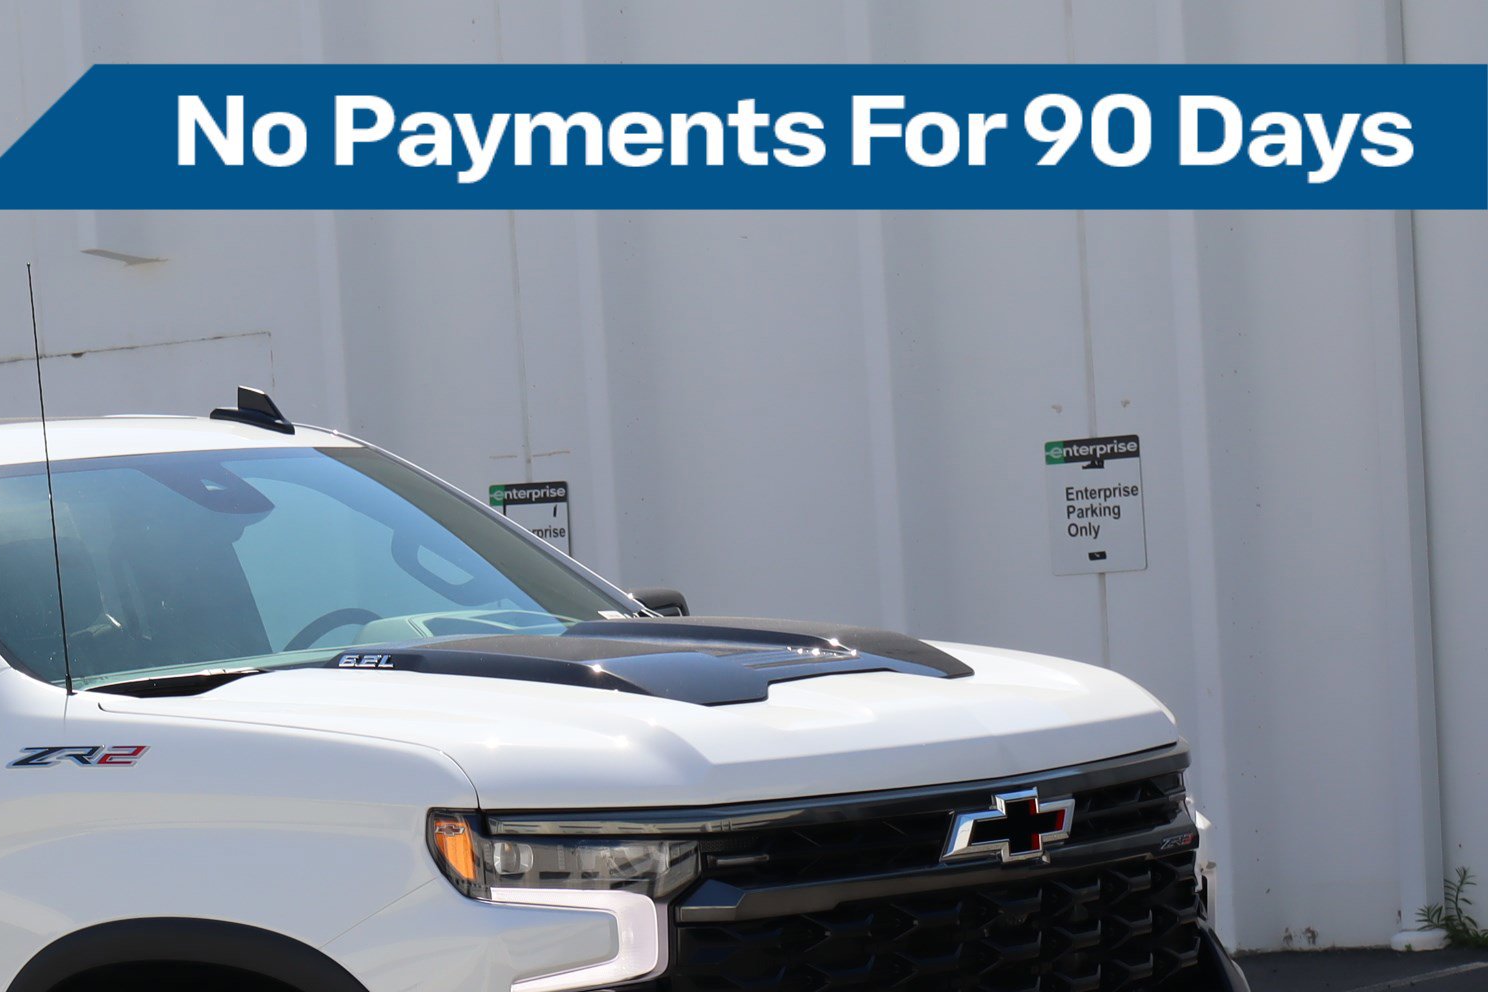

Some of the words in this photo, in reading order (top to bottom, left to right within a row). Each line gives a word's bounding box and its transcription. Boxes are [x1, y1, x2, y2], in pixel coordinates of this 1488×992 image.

[1048, 440, 1138, 459] enterprise
[493, 485, 566, 502] enterprise
[1065, 483, 1139, 501] Enterprise
[1066, 504, 1121, 520] Parking
[530, 525, 566, 539] rprise
[1067, 522, 1100, 539] Only
[6, 744, 151, 769] ZR2
